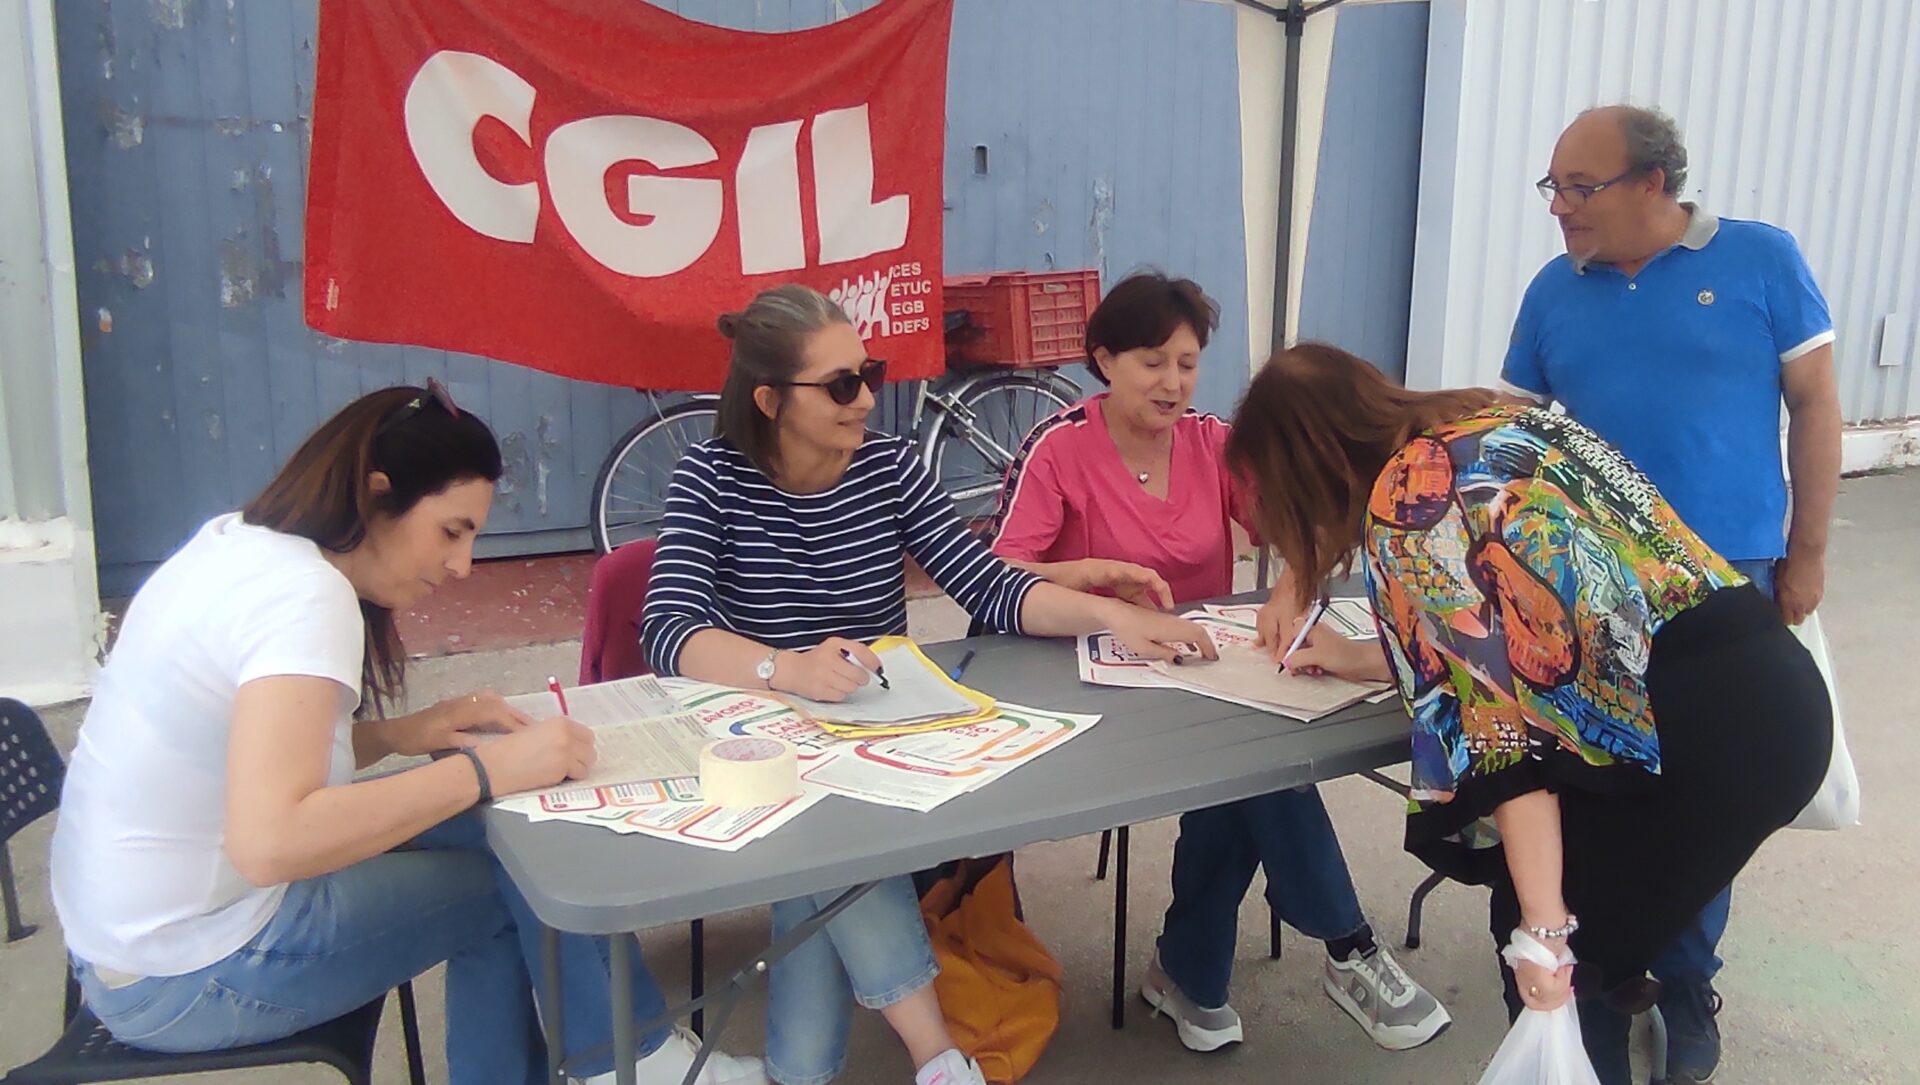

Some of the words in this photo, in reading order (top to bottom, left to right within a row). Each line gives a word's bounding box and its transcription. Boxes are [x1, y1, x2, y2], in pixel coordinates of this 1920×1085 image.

[404, 49, 910, 278] CGIL
[892, 262, 922, 278] CES
[891, 279, 932, 297] ETUC
[891, 300, 925, 316] EGB
[892, 317, 930, 335] DEFS
